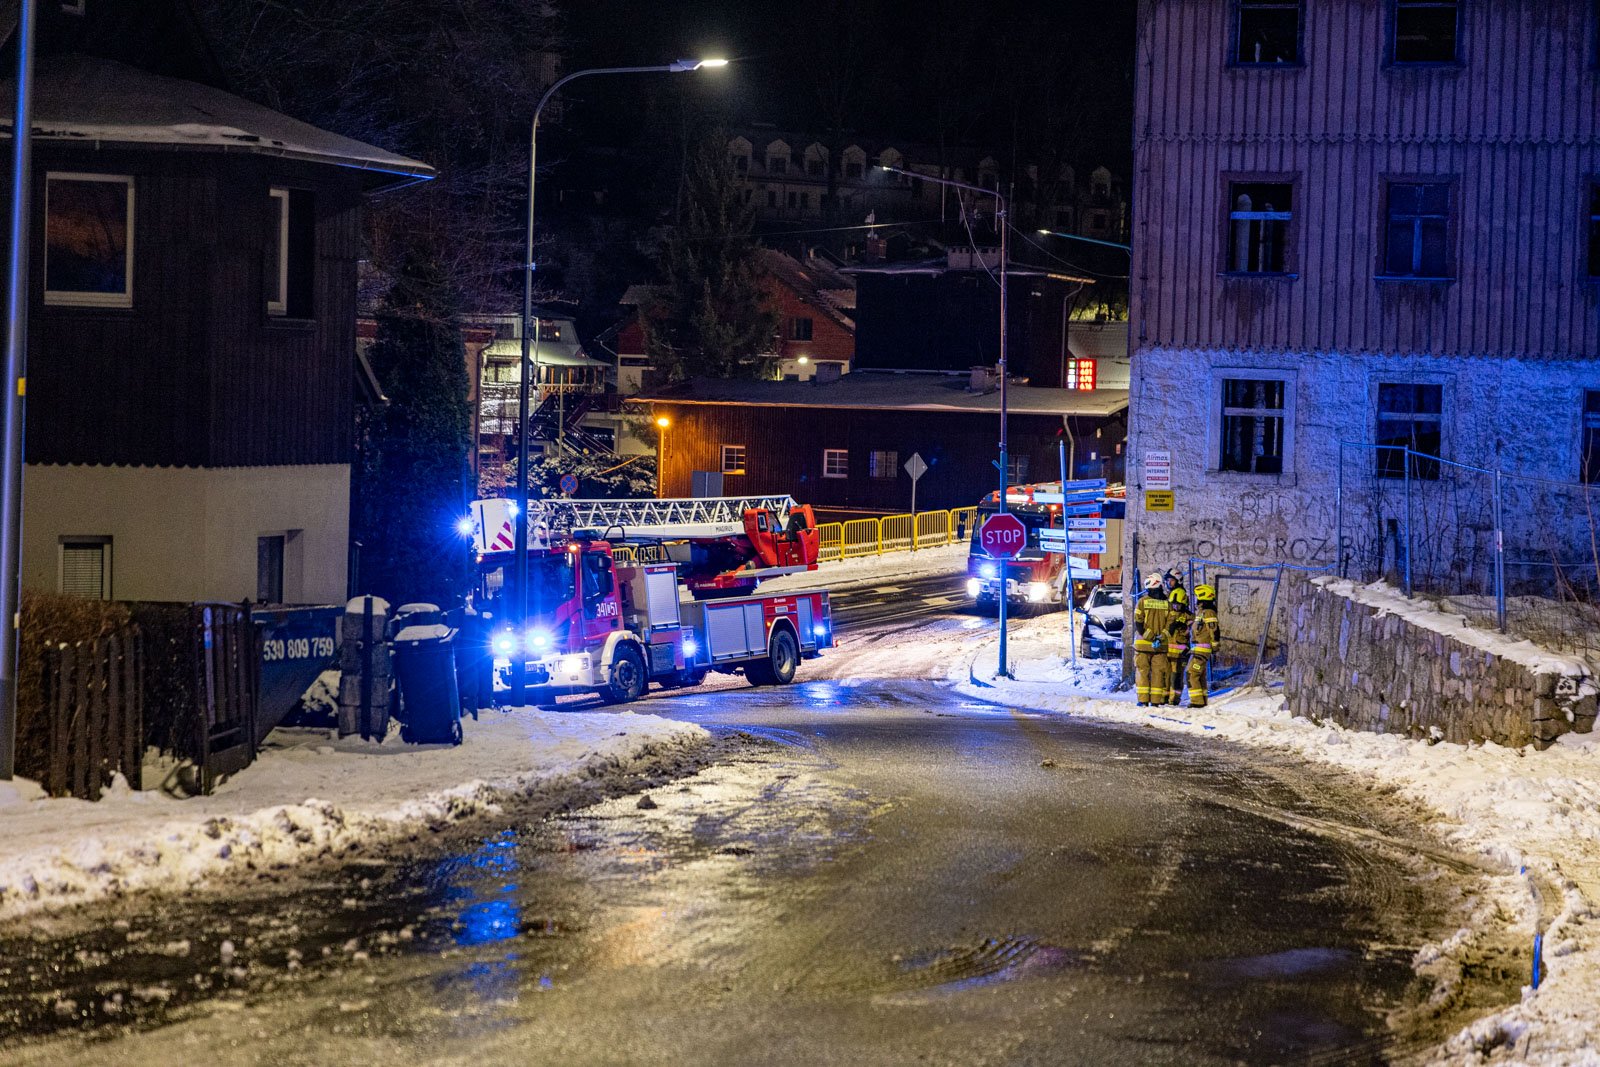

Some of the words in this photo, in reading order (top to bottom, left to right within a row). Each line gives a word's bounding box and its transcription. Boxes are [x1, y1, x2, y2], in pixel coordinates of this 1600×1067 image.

[985, 529, 1021, 544] STOP
[263, 639, 285, 661] 530
[287, 637, 309, 659] 809
[311, 636, 334, 658] 759
